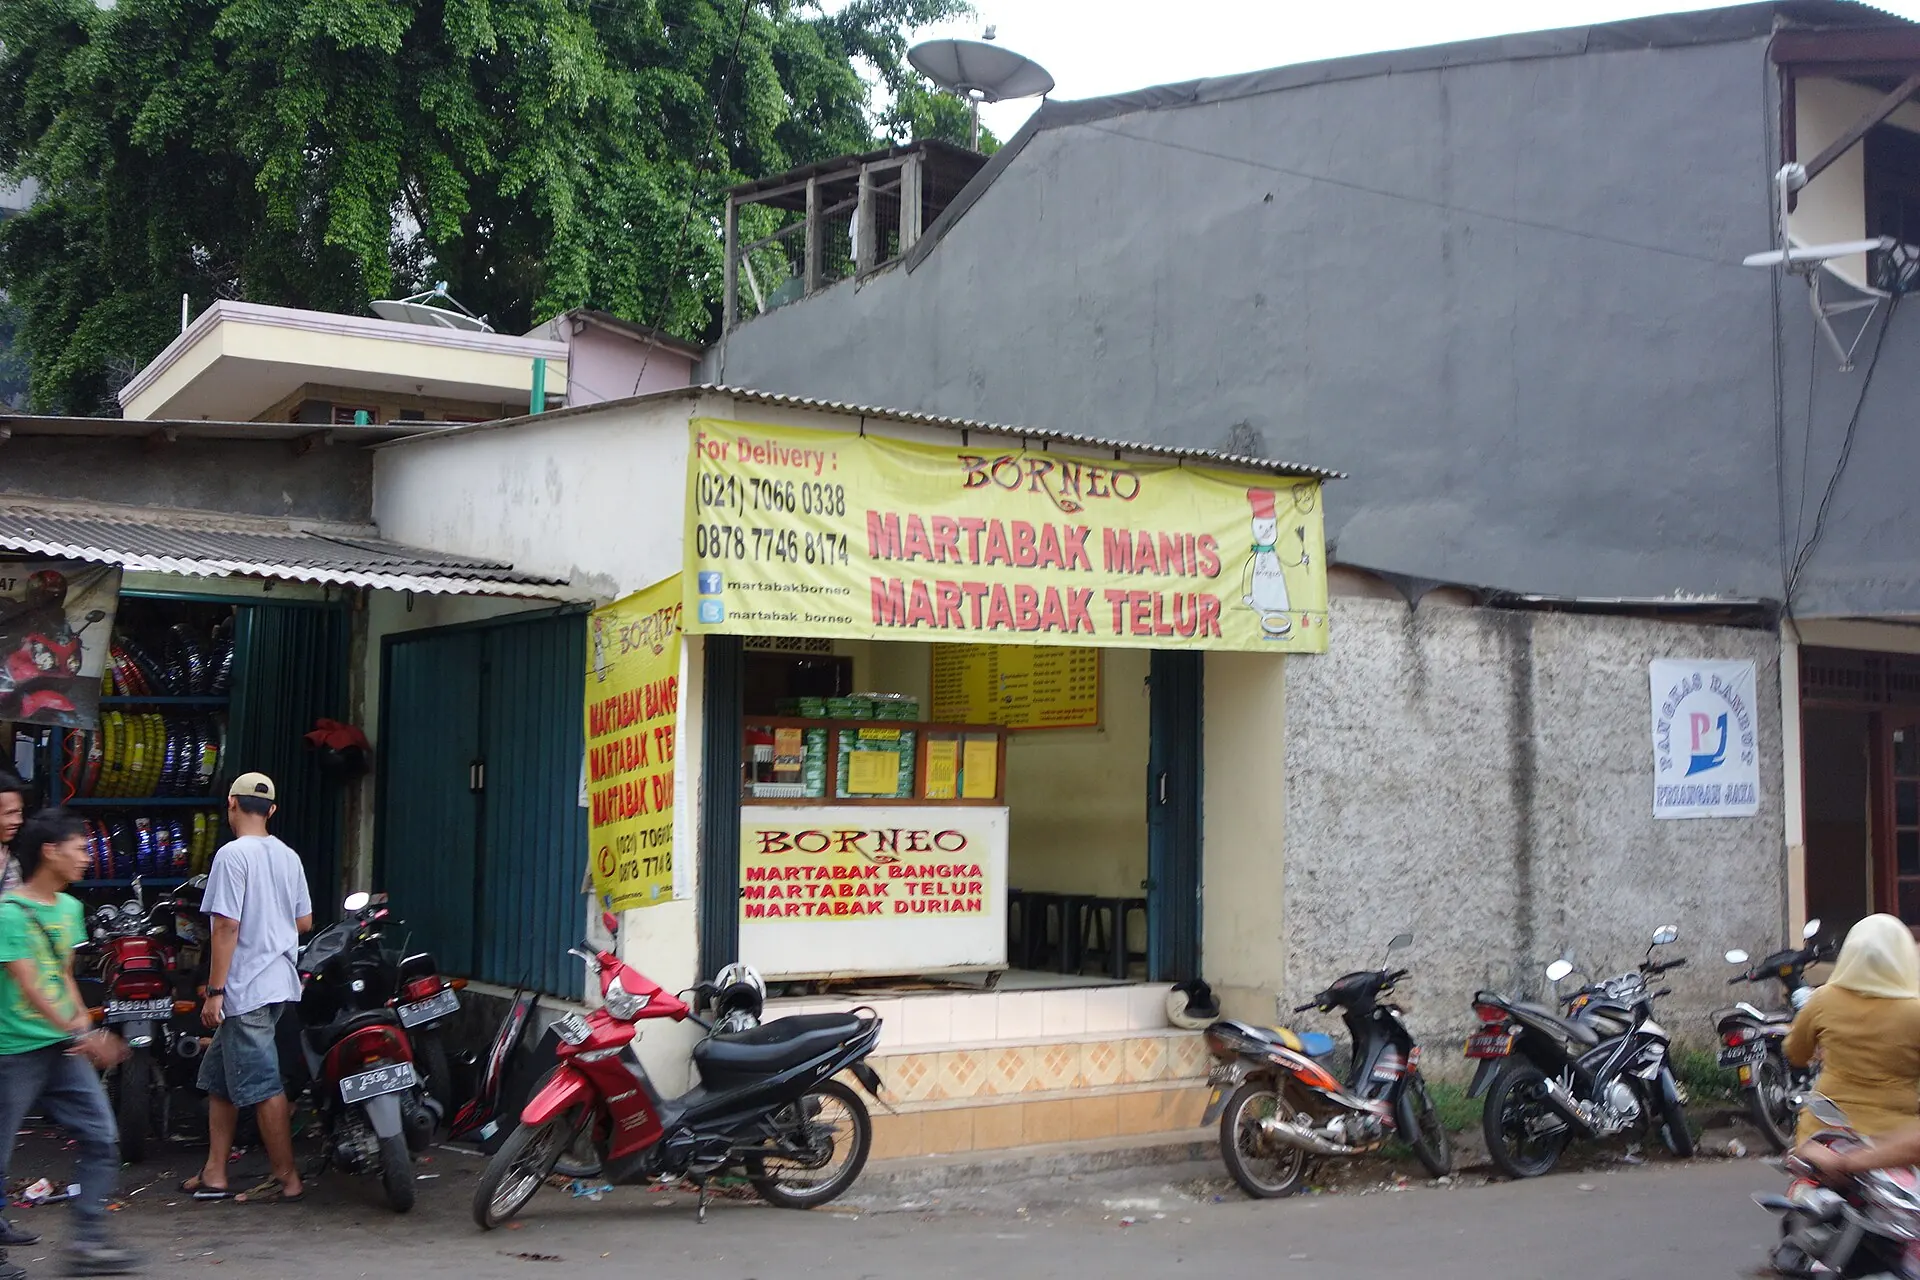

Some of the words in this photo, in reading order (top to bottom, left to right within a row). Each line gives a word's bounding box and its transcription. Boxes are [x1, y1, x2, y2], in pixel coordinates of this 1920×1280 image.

[695, 432, 730, 460] For
[738, 436, 824, 476] Delivery
[695, 471, 744, 518] (021)
[750, 477, 796, 513] 7066
[802, 481, 846, 517] 0338
[957, 454, 1140, 514] BORNEO
[696, 523, 745, 560] 0878
[752, 527, 798, 563] 7746
[805, 531, 849, 566] 8174
[867, 510, 1093, 572] MARTABAK
[1103, 527, 1222, 578] MANIS
[727, 580, 851, 596] martabakborneo
[870, 577, 1096, 635] MARTABAK
[1104, 589, 1222, 638] TELUR
[589, 686, 643, 740] MARTABAK
[645, 675, 679, 720] BANG
[589, 731, 649, 784] MARTABAK
[653, 725, 676, 764] TE
[592, 777, 649, 829] MARTABAK
[756, 828, 968, 864] BORNEO
[745, 882, 889, 900] MARTABAK
[904, 881, 983, 896] TELUR
[746, 865, 881, 882] MARTABAK
[888, 863, 983, 880] BANGKA
[745, 900, 883, 918] MARTABAK
[894, 898, 982, 914] DURIAN
